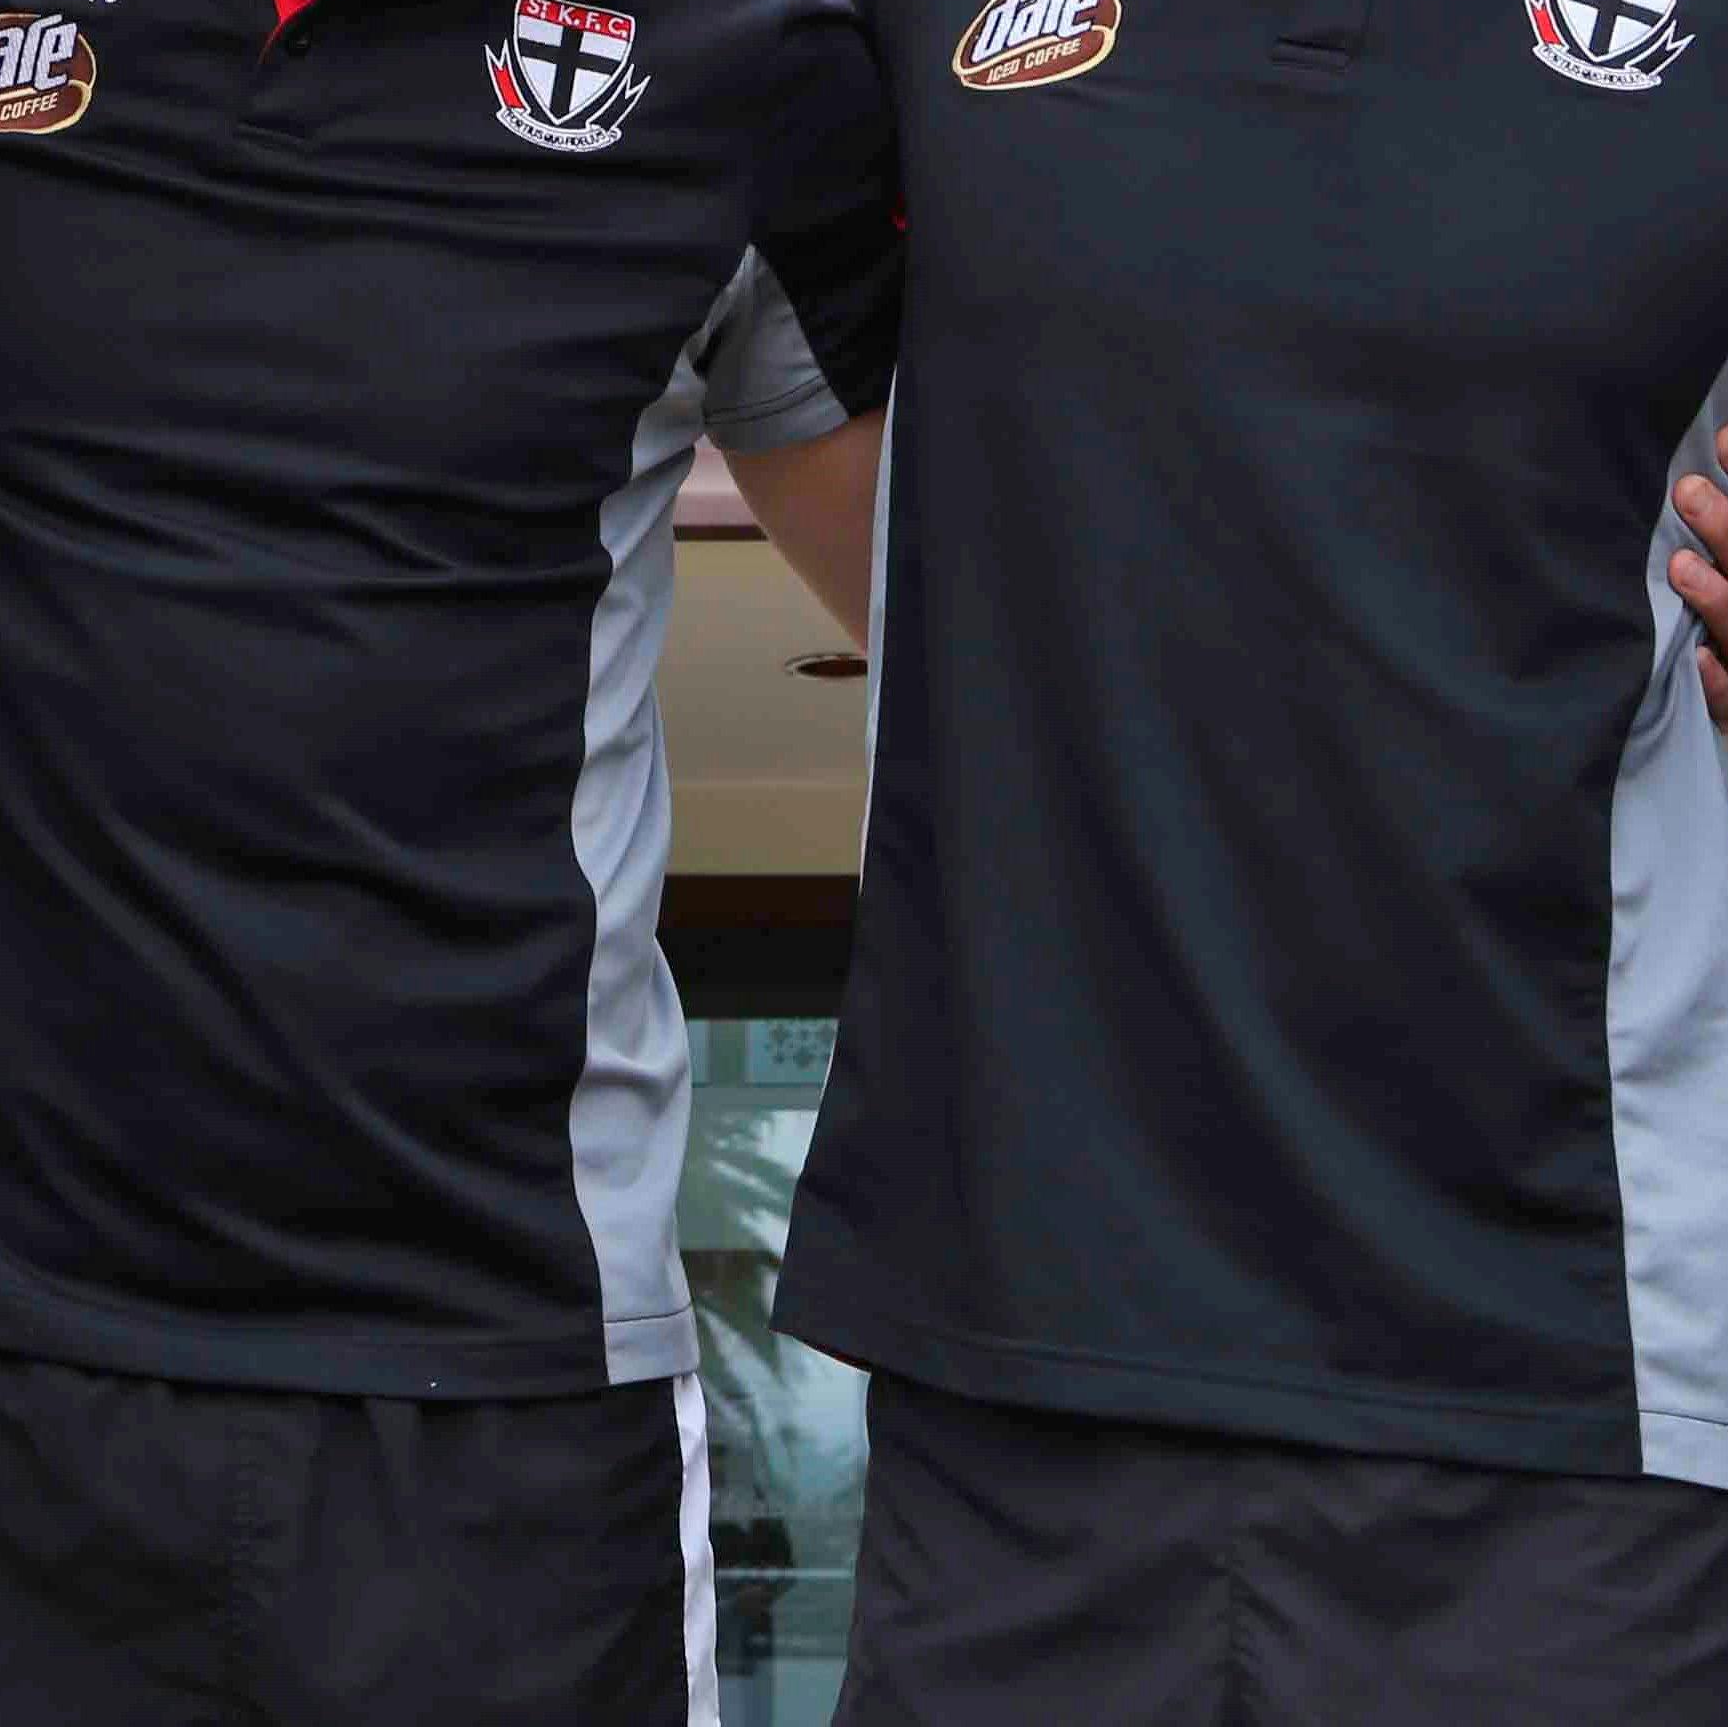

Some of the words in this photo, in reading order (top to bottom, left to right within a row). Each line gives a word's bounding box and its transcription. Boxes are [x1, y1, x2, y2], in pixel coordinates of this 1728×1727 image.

[986, 59, 1021, 84] ICED
[1024, 38, 1082, 70] COFFEE
[0, 92, 59, 121] COFFEE
